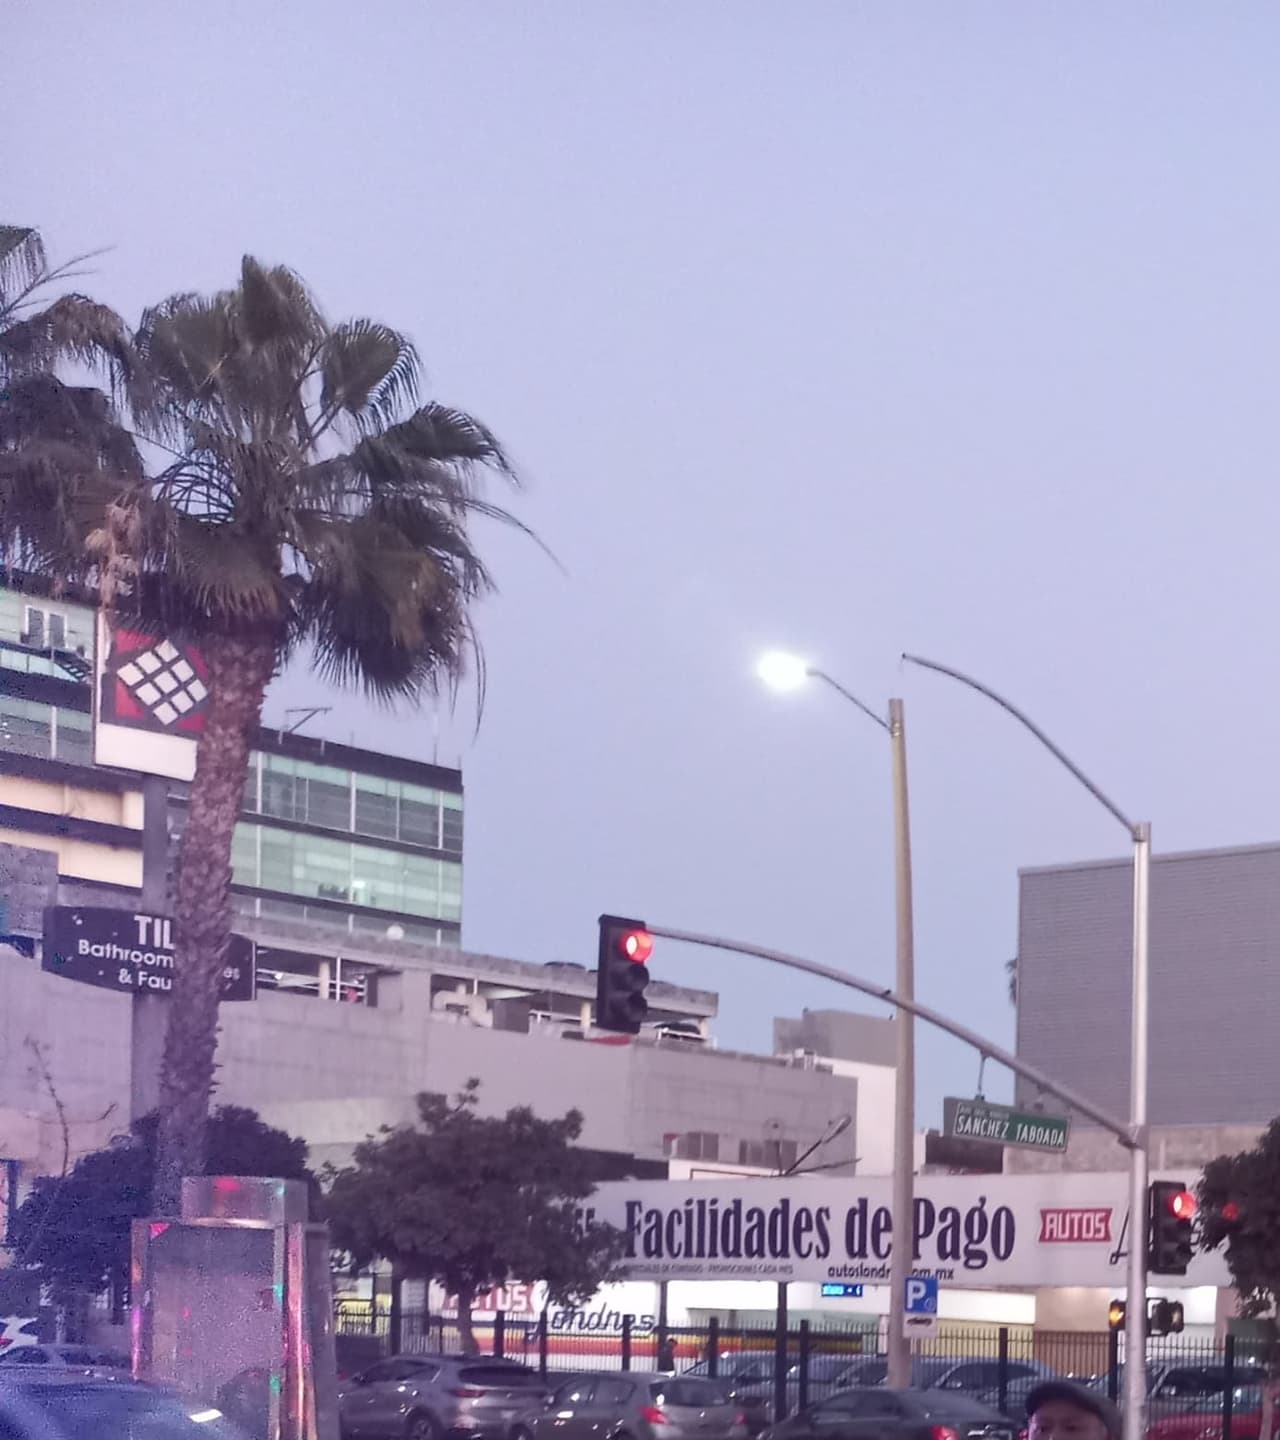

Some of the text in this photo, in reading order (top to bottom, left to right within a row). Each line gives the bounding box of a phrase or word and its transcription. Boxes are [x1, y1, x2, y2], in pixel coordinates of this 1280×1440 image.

[134, 914, 176, 950] TIL
[78, 938, 174, 969] Bathroom
[118, 968, 133, 985] &
[956, 1114, 1066, 1147] SANCHEZ TABOADA
[624, 1197, 831, 1260] Facilidades
[845, 1197, 893, 1260] de
[911, 1195, 1016, 1270] Pago
[1045, 1212, 1108, 1241] AUTOS
[906, 1280, 927, 1309] P
